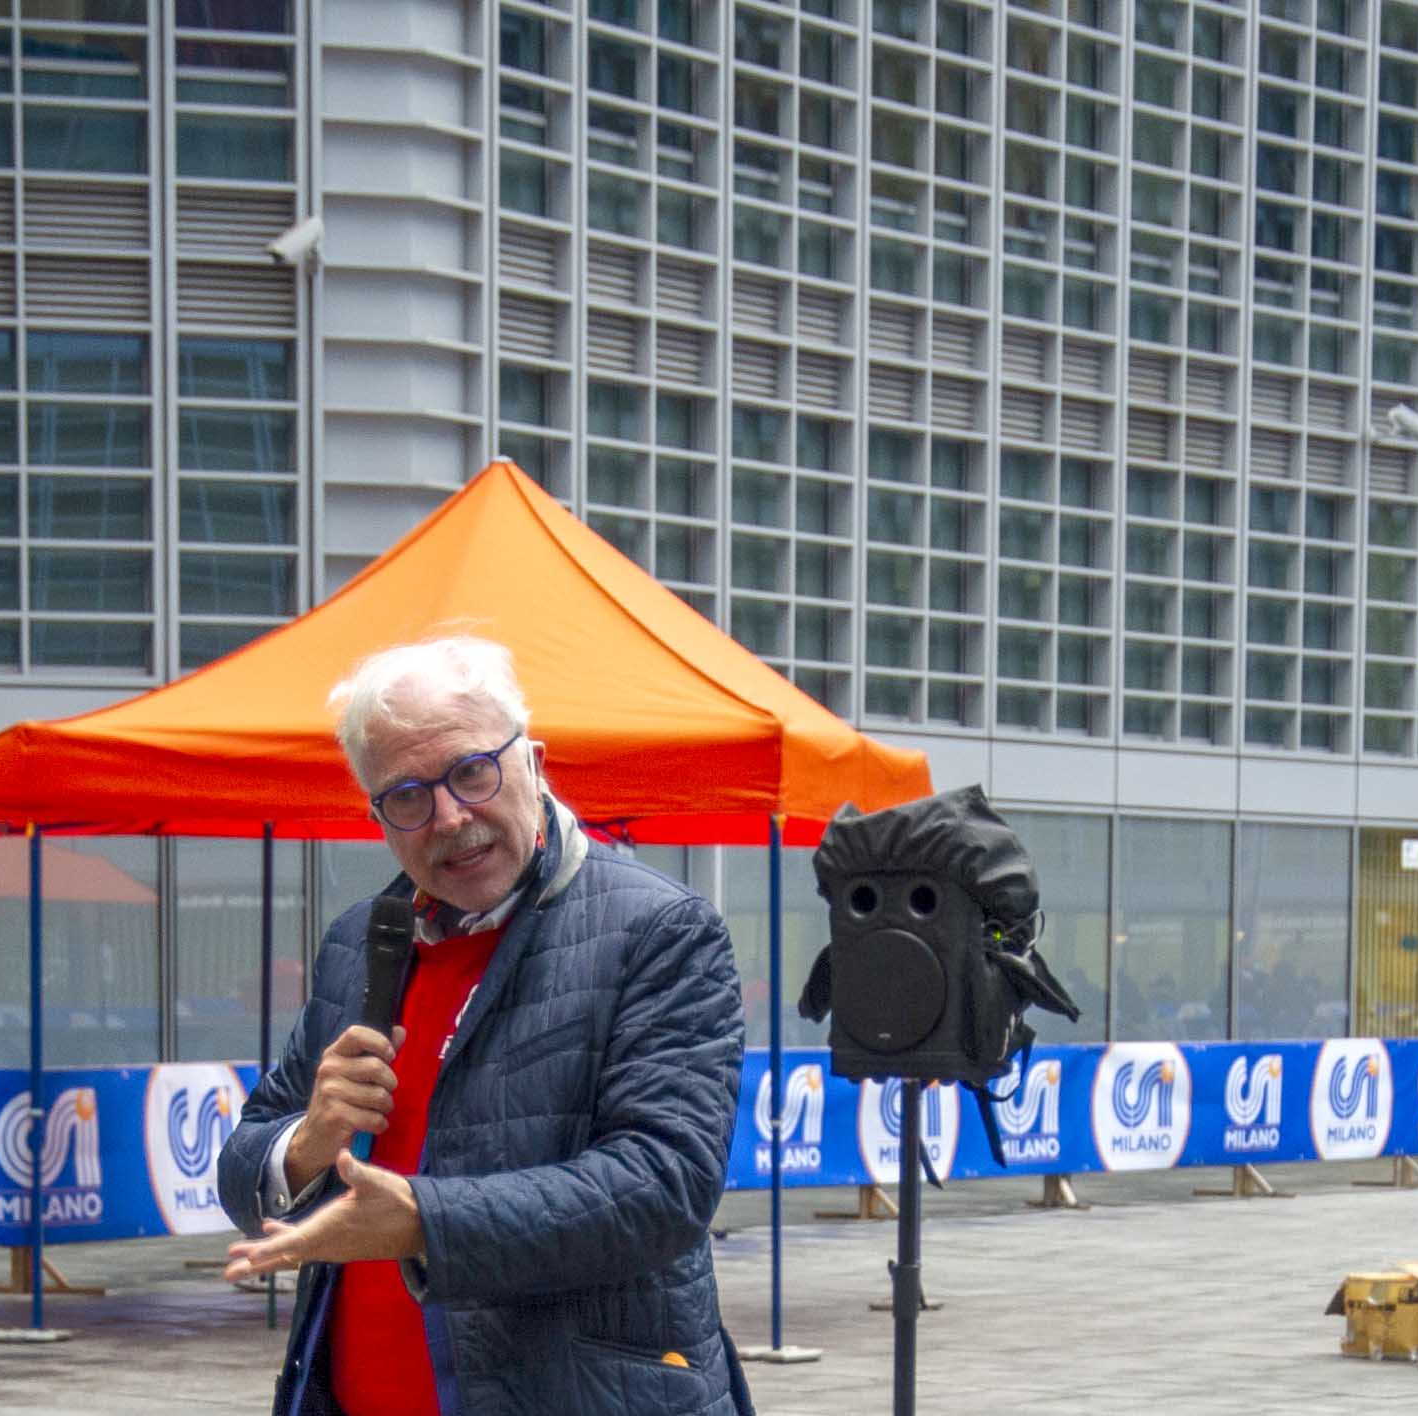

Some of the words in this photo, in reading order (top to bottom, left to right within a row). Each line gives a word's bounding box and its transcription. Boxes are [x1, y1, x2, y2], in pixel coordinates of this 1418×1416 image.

[1111, 1133, 1172, 1153] MILANO
[1225, 1126, 1281, 1150] MILANO
[1328, 1124, 1377, 1142] MILANO
[173, 1187, 219, 1211] MILA
